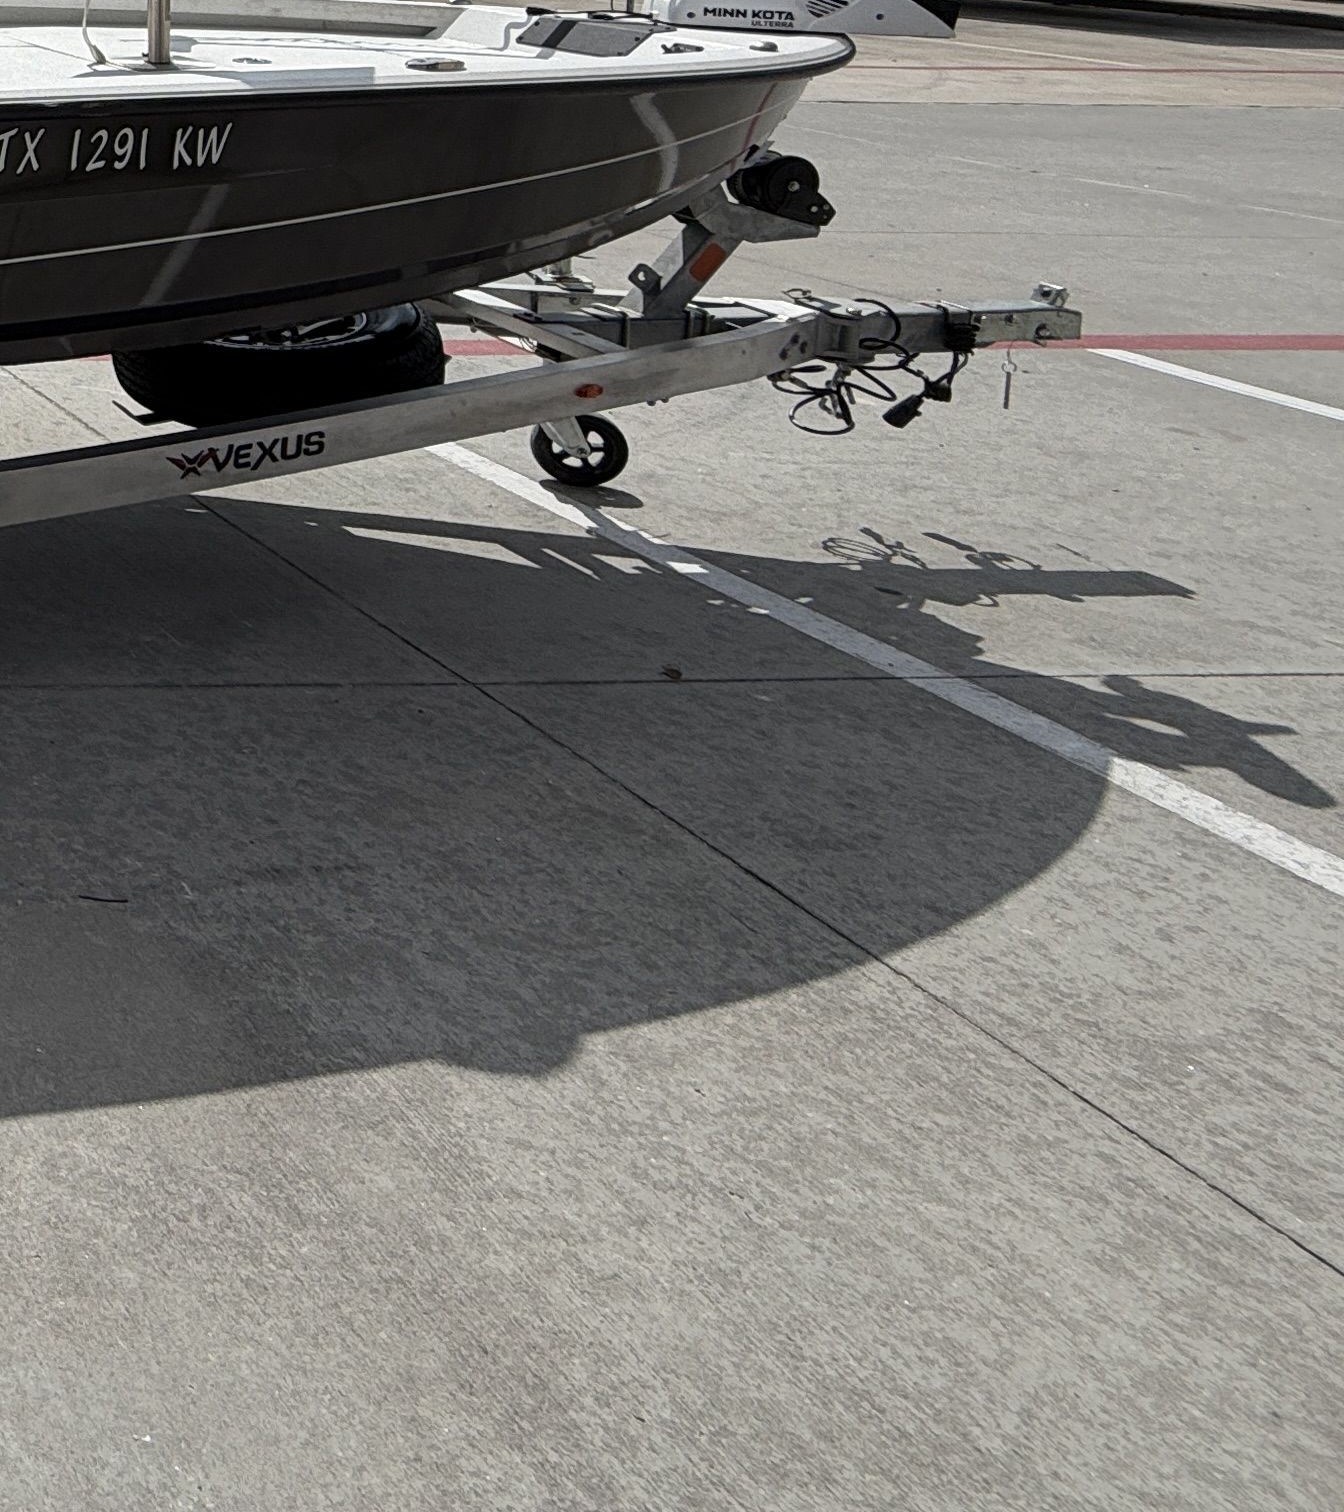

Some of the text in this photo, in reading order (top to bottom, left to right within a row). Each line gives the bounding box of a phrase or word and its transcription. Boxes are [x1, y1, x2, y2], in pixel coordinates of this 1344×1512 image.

[703, 6, 795, 21] MINN KOTA
[750, 20, 794, 28] ULTERRA
[70, 127, 149, 172] 1291
[172, 122, 233, 170] KW
[207, 430, 326, 473] VEXUS
